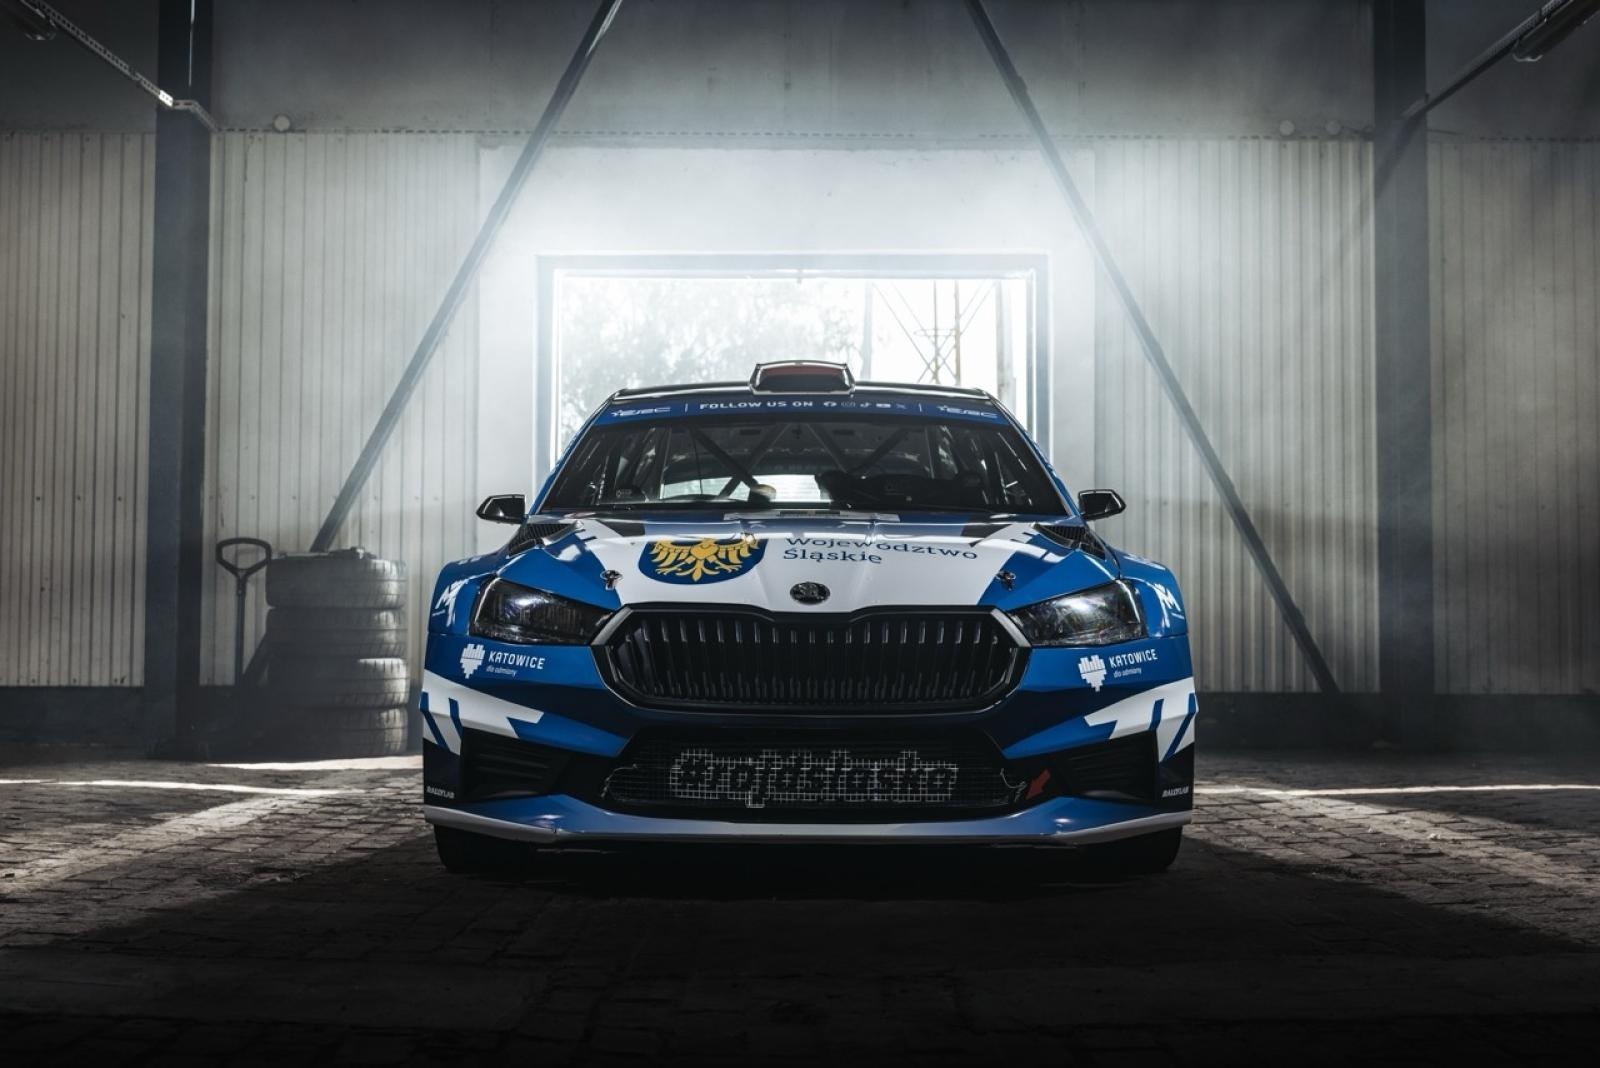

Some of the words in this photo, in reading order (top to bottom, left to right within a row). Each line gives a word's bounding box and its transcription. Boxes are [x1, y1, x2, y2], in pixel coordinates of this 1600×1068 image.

[699, 401, 762, 410] FOLLOW
[783, 548, 882, 564] Śląskie
[786, 537, 978, 560] Województwo
[488, 650, 546, 670] KATOWICE
[1109, 648, 1158, 668] KATOWICE
